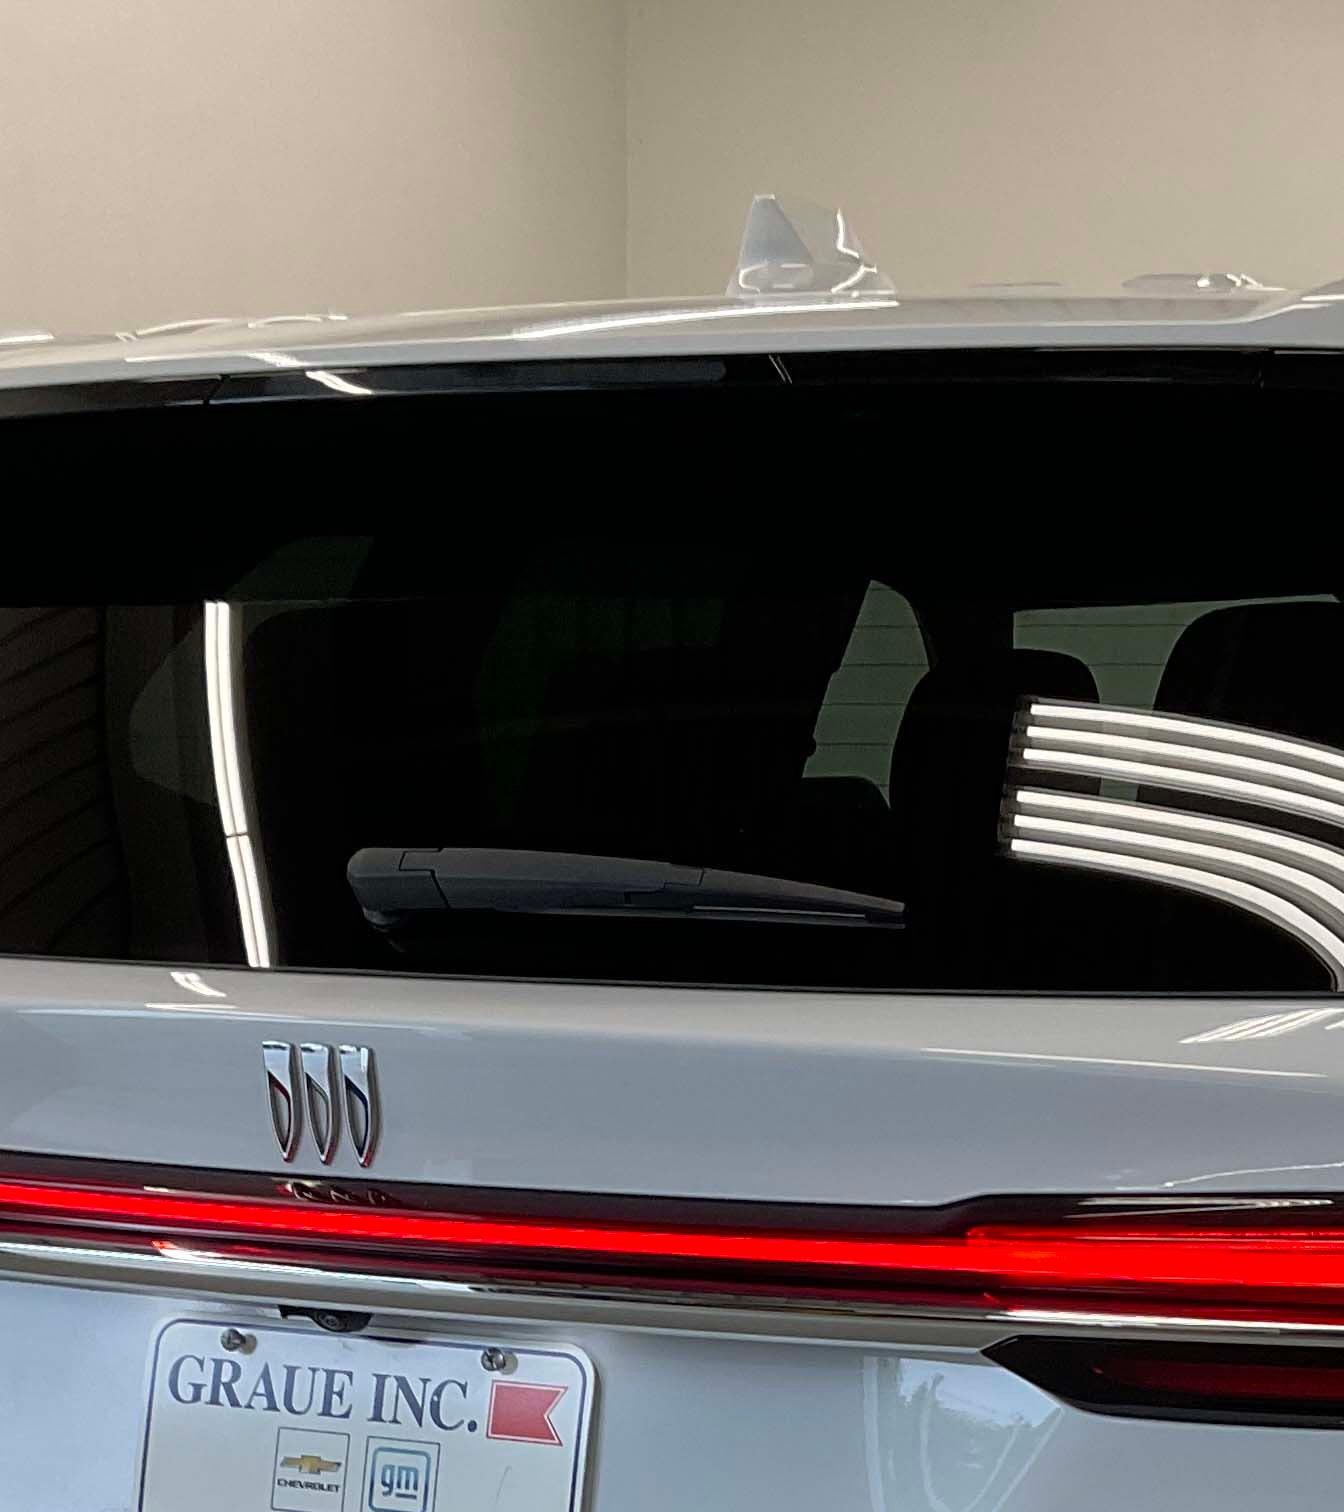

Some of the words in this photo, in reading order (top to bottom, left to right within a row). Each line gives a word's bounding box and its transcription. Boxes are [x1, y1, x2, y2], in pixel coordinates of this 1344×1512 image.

[167, 1354, 354, 1421] GRAUE
[367, 1373, 478, 1433] INC.
[276, 1477, 342, 1495] CHEVROLET
[380, 1463, 420, 1499] gm
